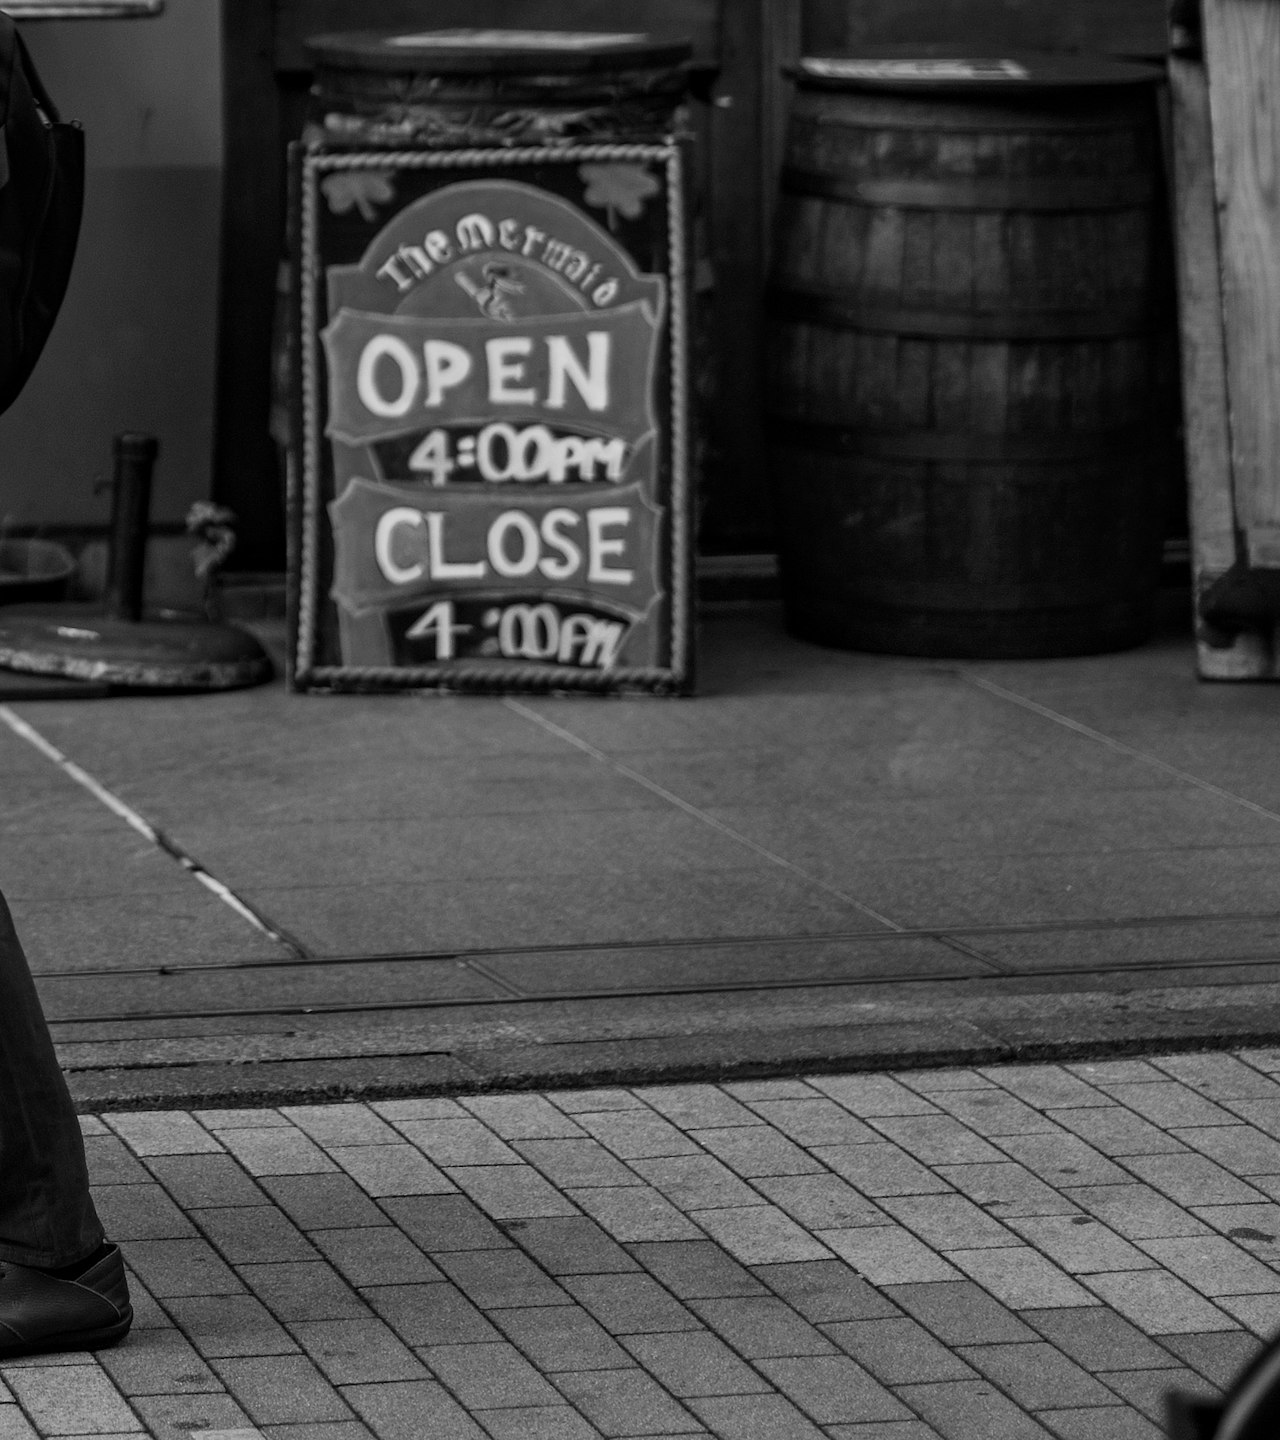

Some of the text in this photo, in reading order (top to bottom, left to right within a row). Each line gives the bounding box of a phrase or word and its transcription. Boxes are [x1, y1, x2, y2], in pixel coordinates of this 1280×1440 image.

[376, 212, 620, 308] The Mermaid
[356, 330, 611, 419] OPEN
[408, 422, 627, 488] 4:00PM
[375, 506, 635, 585] CLOSE
